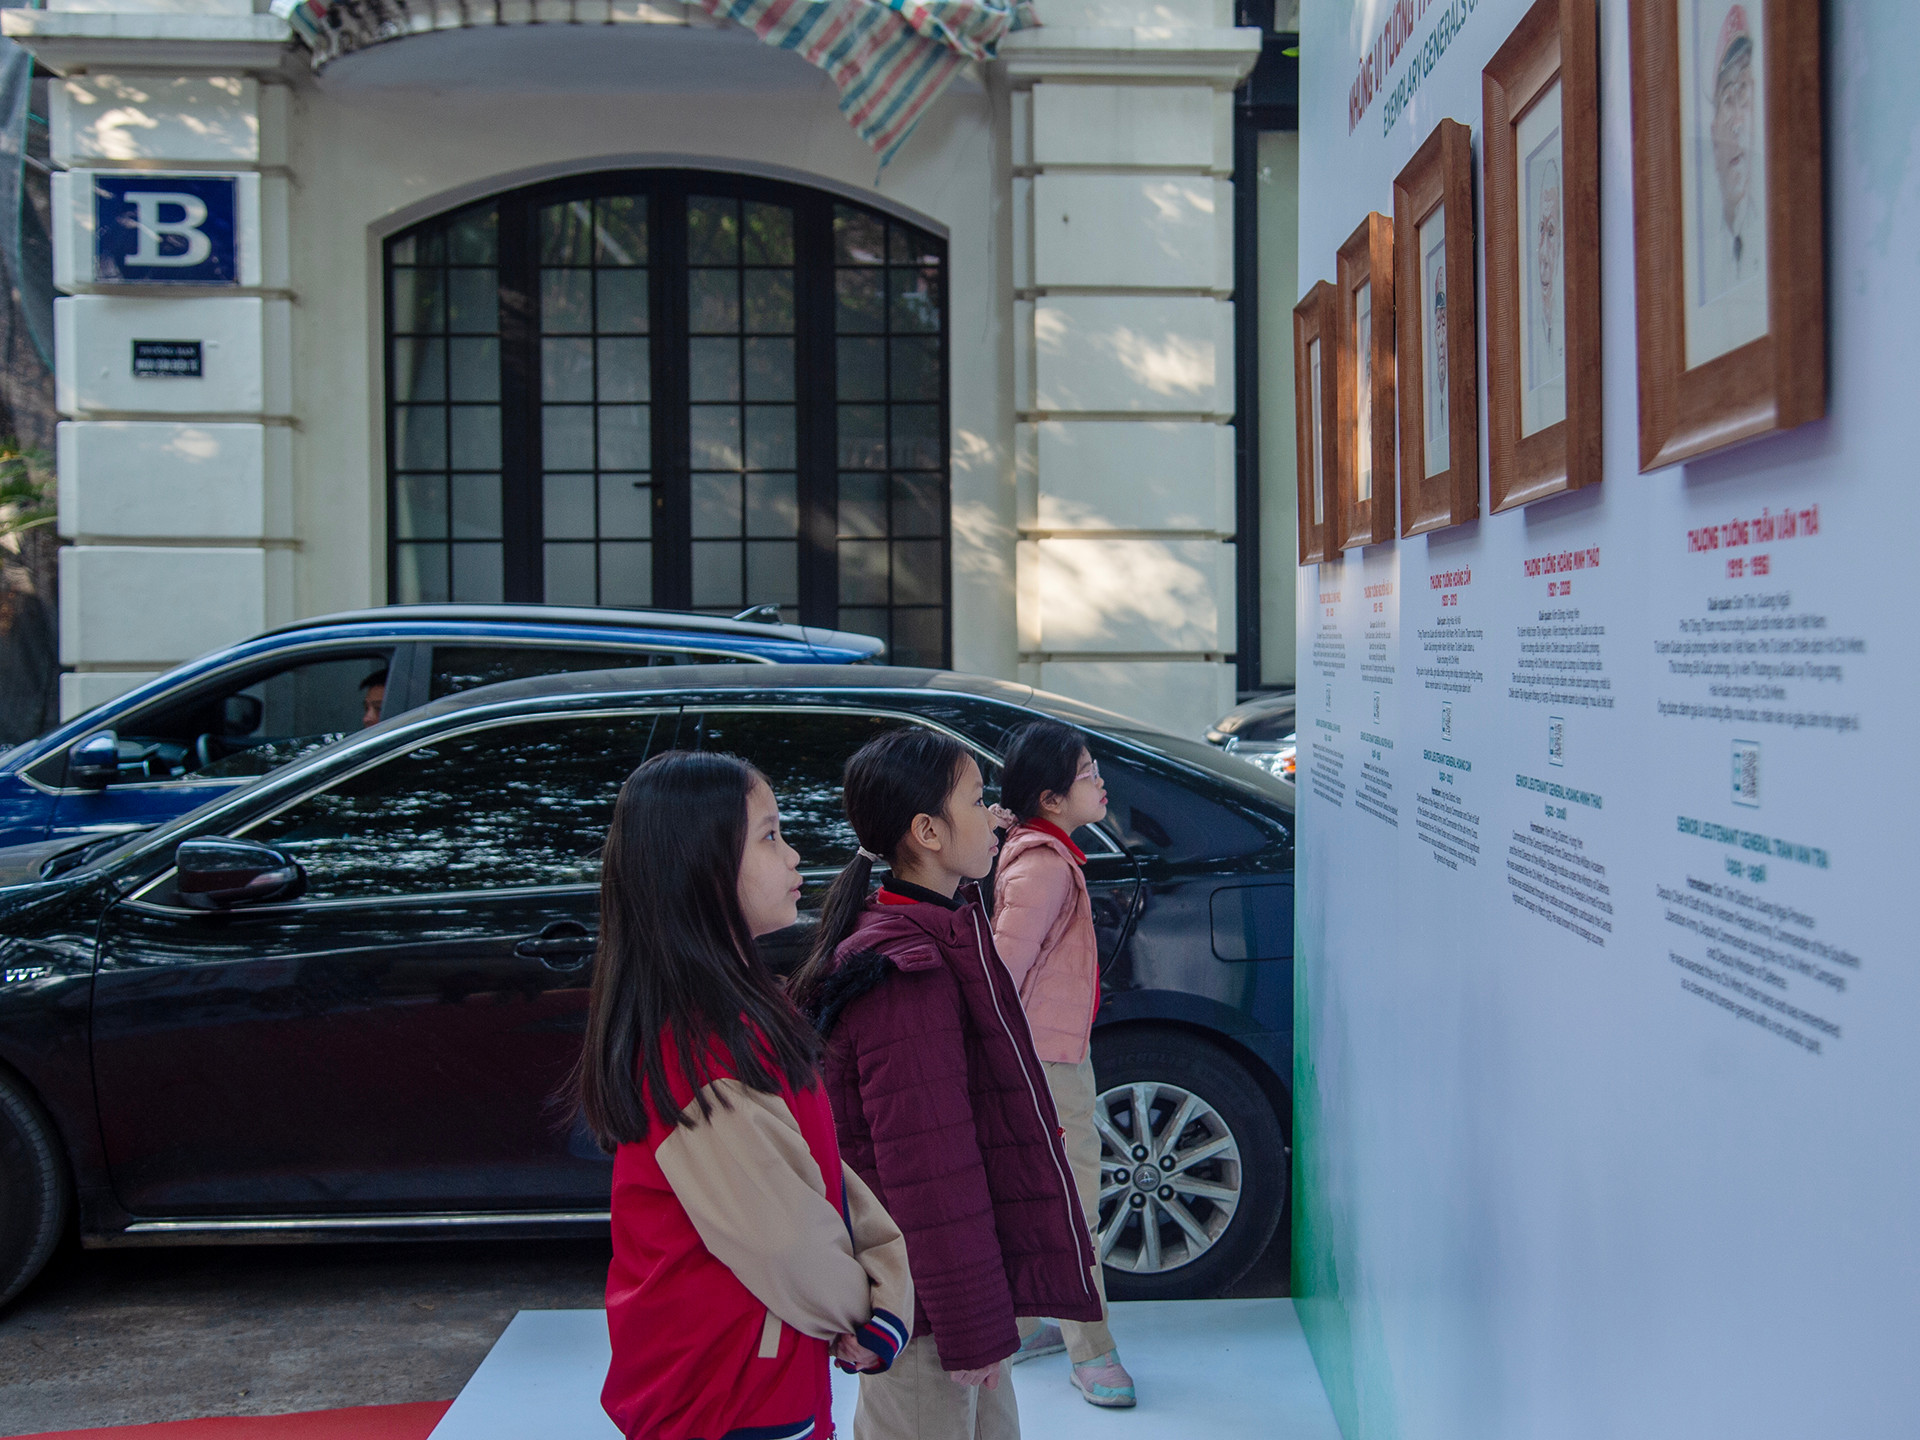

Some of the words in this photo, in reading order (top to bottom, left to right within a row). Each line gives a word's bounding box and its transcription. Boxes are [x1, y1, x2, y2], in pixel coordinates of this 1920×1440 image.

[1384, 48, 1422, 138] EXEMPLARY
[1423, 0, 1467, 79] GENERALS
[124, 191, 211, 267] B
